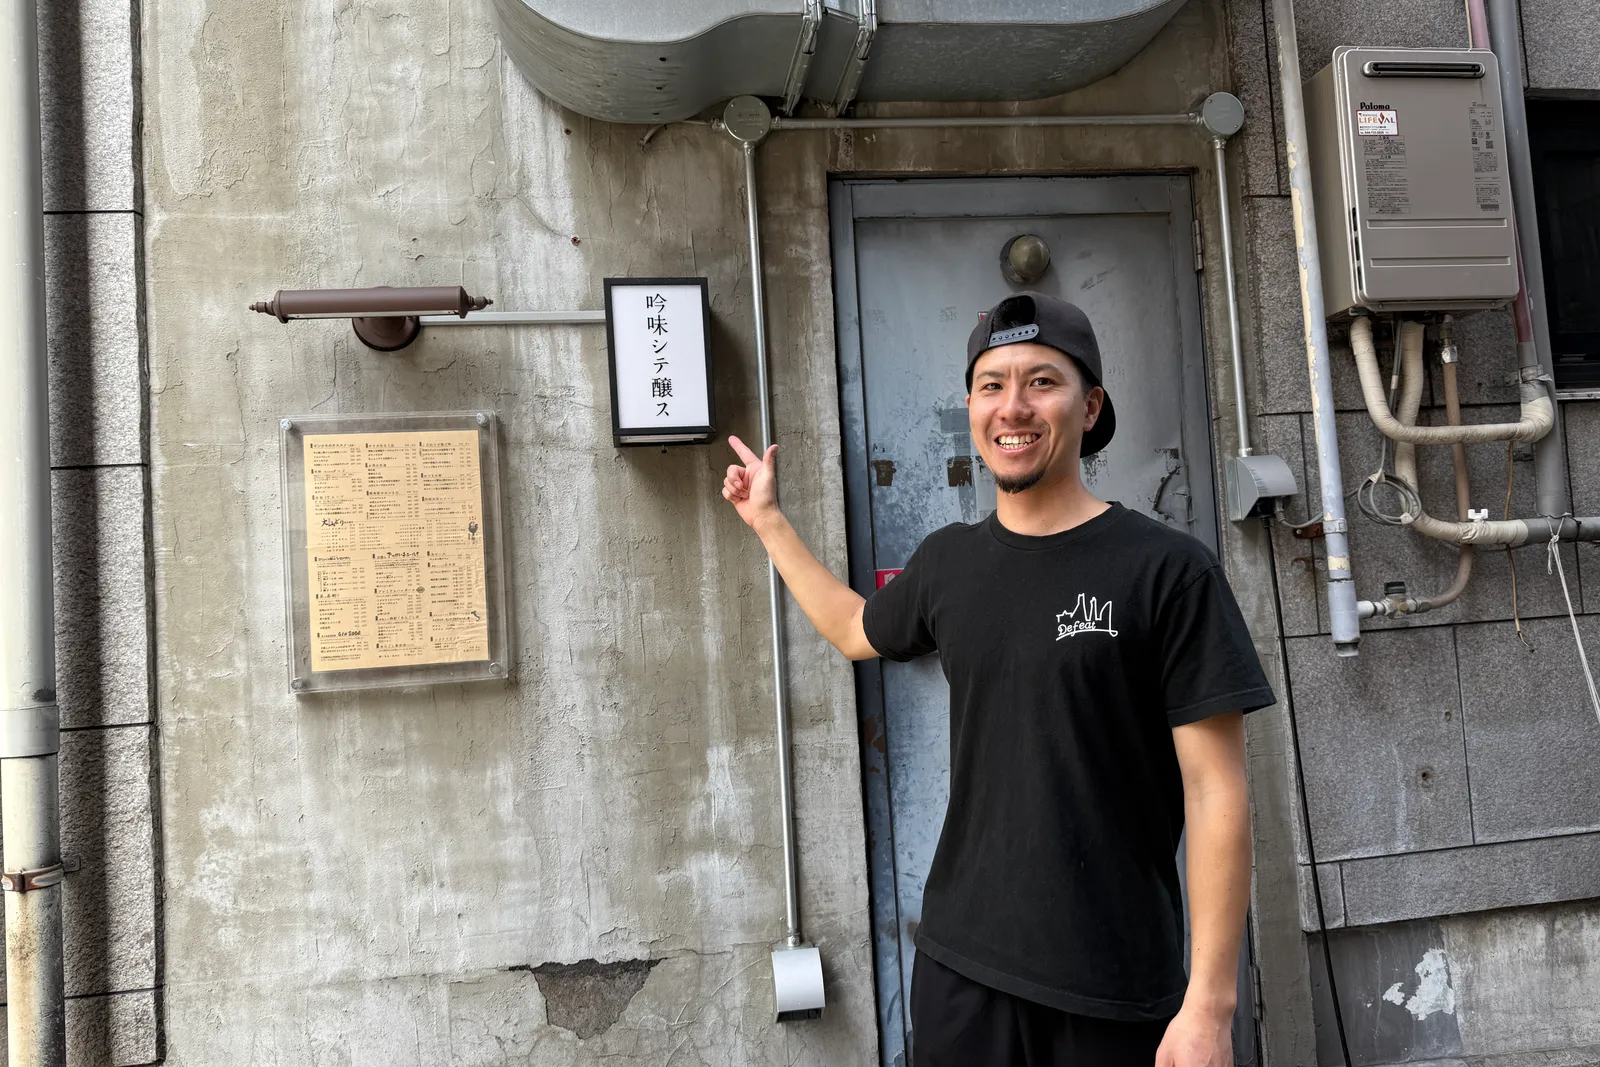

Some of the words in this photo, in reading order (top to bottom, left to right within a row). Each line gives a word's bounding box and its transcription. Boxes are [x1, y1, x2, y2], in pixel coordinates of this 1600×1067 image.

[1360, 102, 1390, 110] Paloma
[1359, 113, 1395, 124] LIFEVAL
[646, 293, 673, 417] 吟味シテ醸ス
[1058, 620, 1096, 636] Defeat
